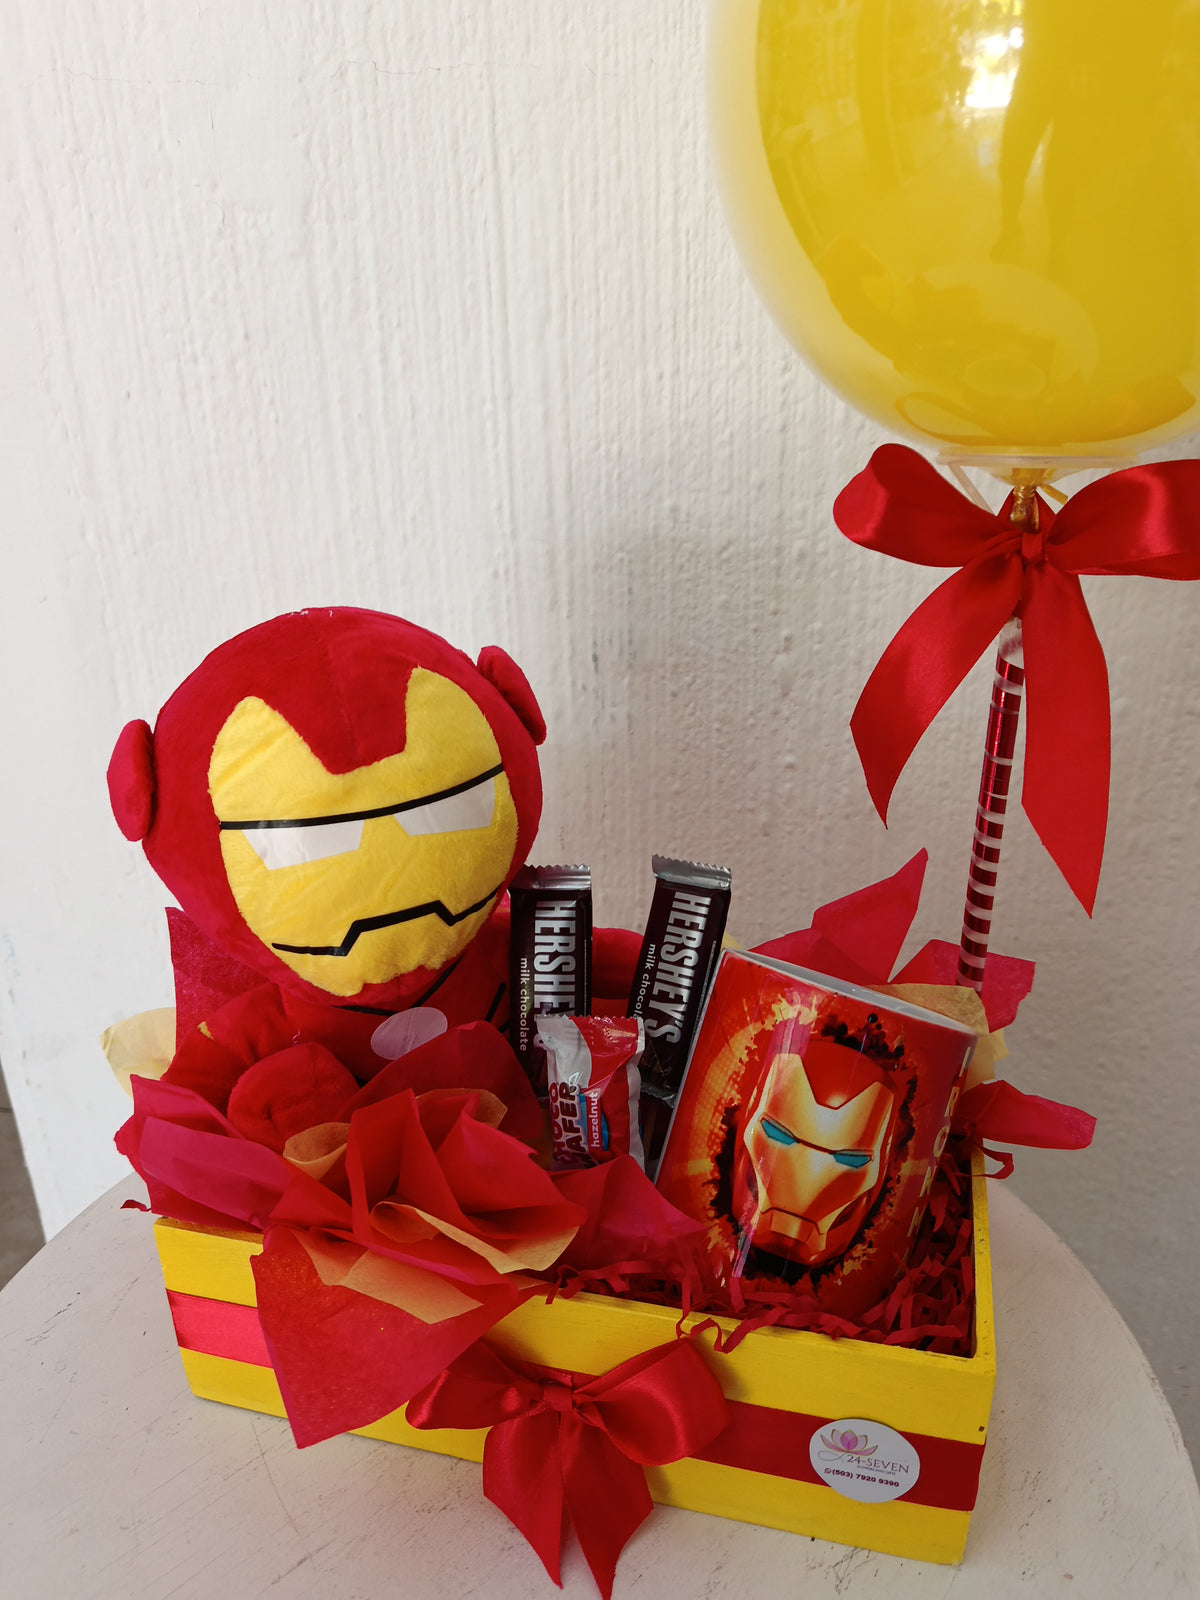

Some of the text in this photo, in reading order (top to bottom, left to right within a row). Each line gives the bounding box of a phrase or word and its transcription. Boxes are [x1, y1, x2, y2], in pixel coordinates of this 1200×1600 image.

[644, 943, 657, 970] milk
[644, 891, 711, 1044] HERSHEY'S
[519, 957, 531, 1052] milk chocolate
[588, 1091, 601, 1148] hazelnut
[831, 1467, 854, 1479] (503)
[855, 1473, 877, 1483] 7920
[846, 1454, 910, 1474] 24-SEVEN
